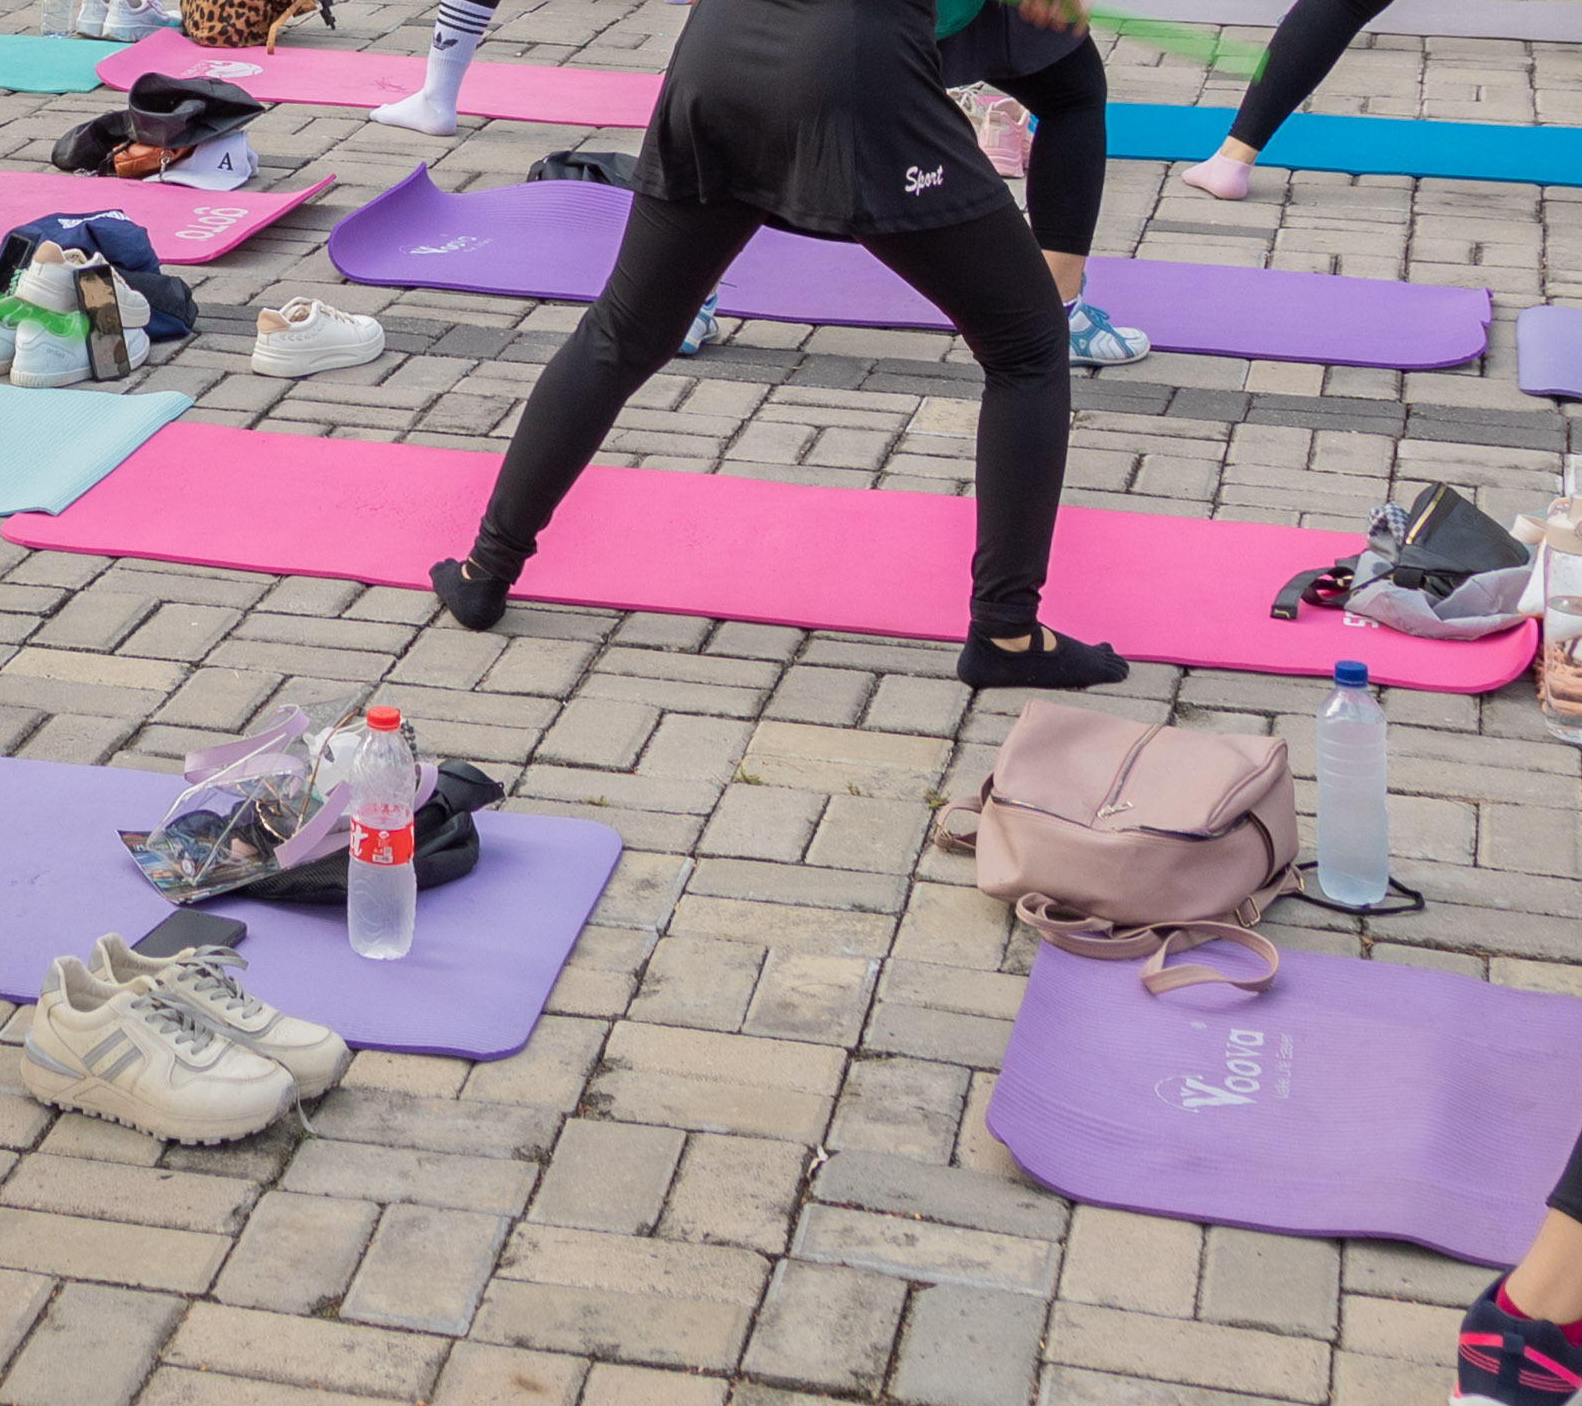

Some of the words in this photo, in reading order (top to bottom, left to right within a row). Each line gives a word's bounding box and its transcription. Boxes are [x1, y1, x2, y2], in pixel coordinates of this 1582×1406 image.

[217, 152, 234, 171] A
[904, 164, 944, 196] Sport
[1179, 1028, 1265, 1108] Voova
